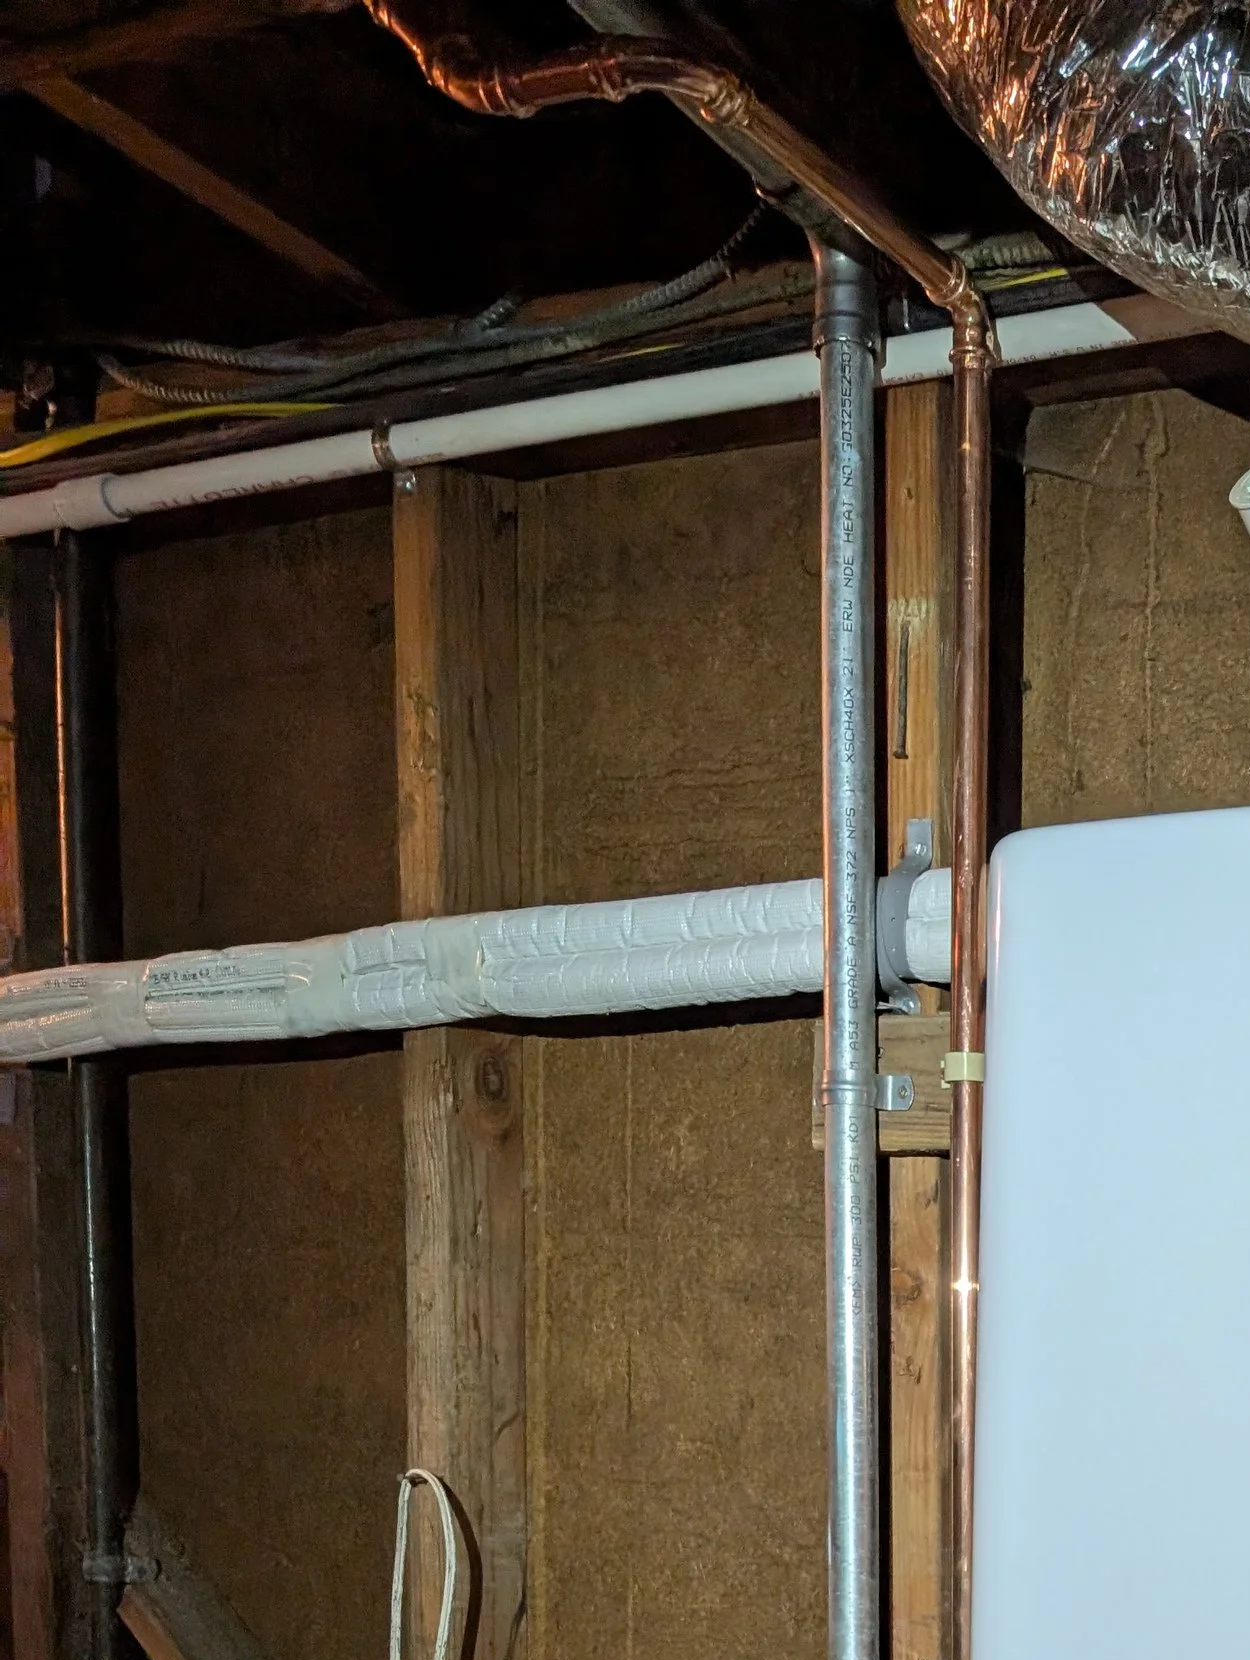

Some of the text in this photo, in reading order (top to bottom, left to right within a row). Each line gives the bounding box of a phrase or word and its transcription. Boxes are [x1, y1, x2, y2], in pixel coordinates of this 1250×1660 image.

[840, 499, 855, 544] HEAT
[841, 555, 855, 589] NDE
[841, 599, 854, 633] ERW
[844, 806, 857, 840] NPS
[845, 849, 858, 883] 372
[845, 895, 858, 926] NSF
[846, 935, 858, 947] A
[846, 955, 860, 1010] GRADE
[848, 1018, 860, 1052] A53
